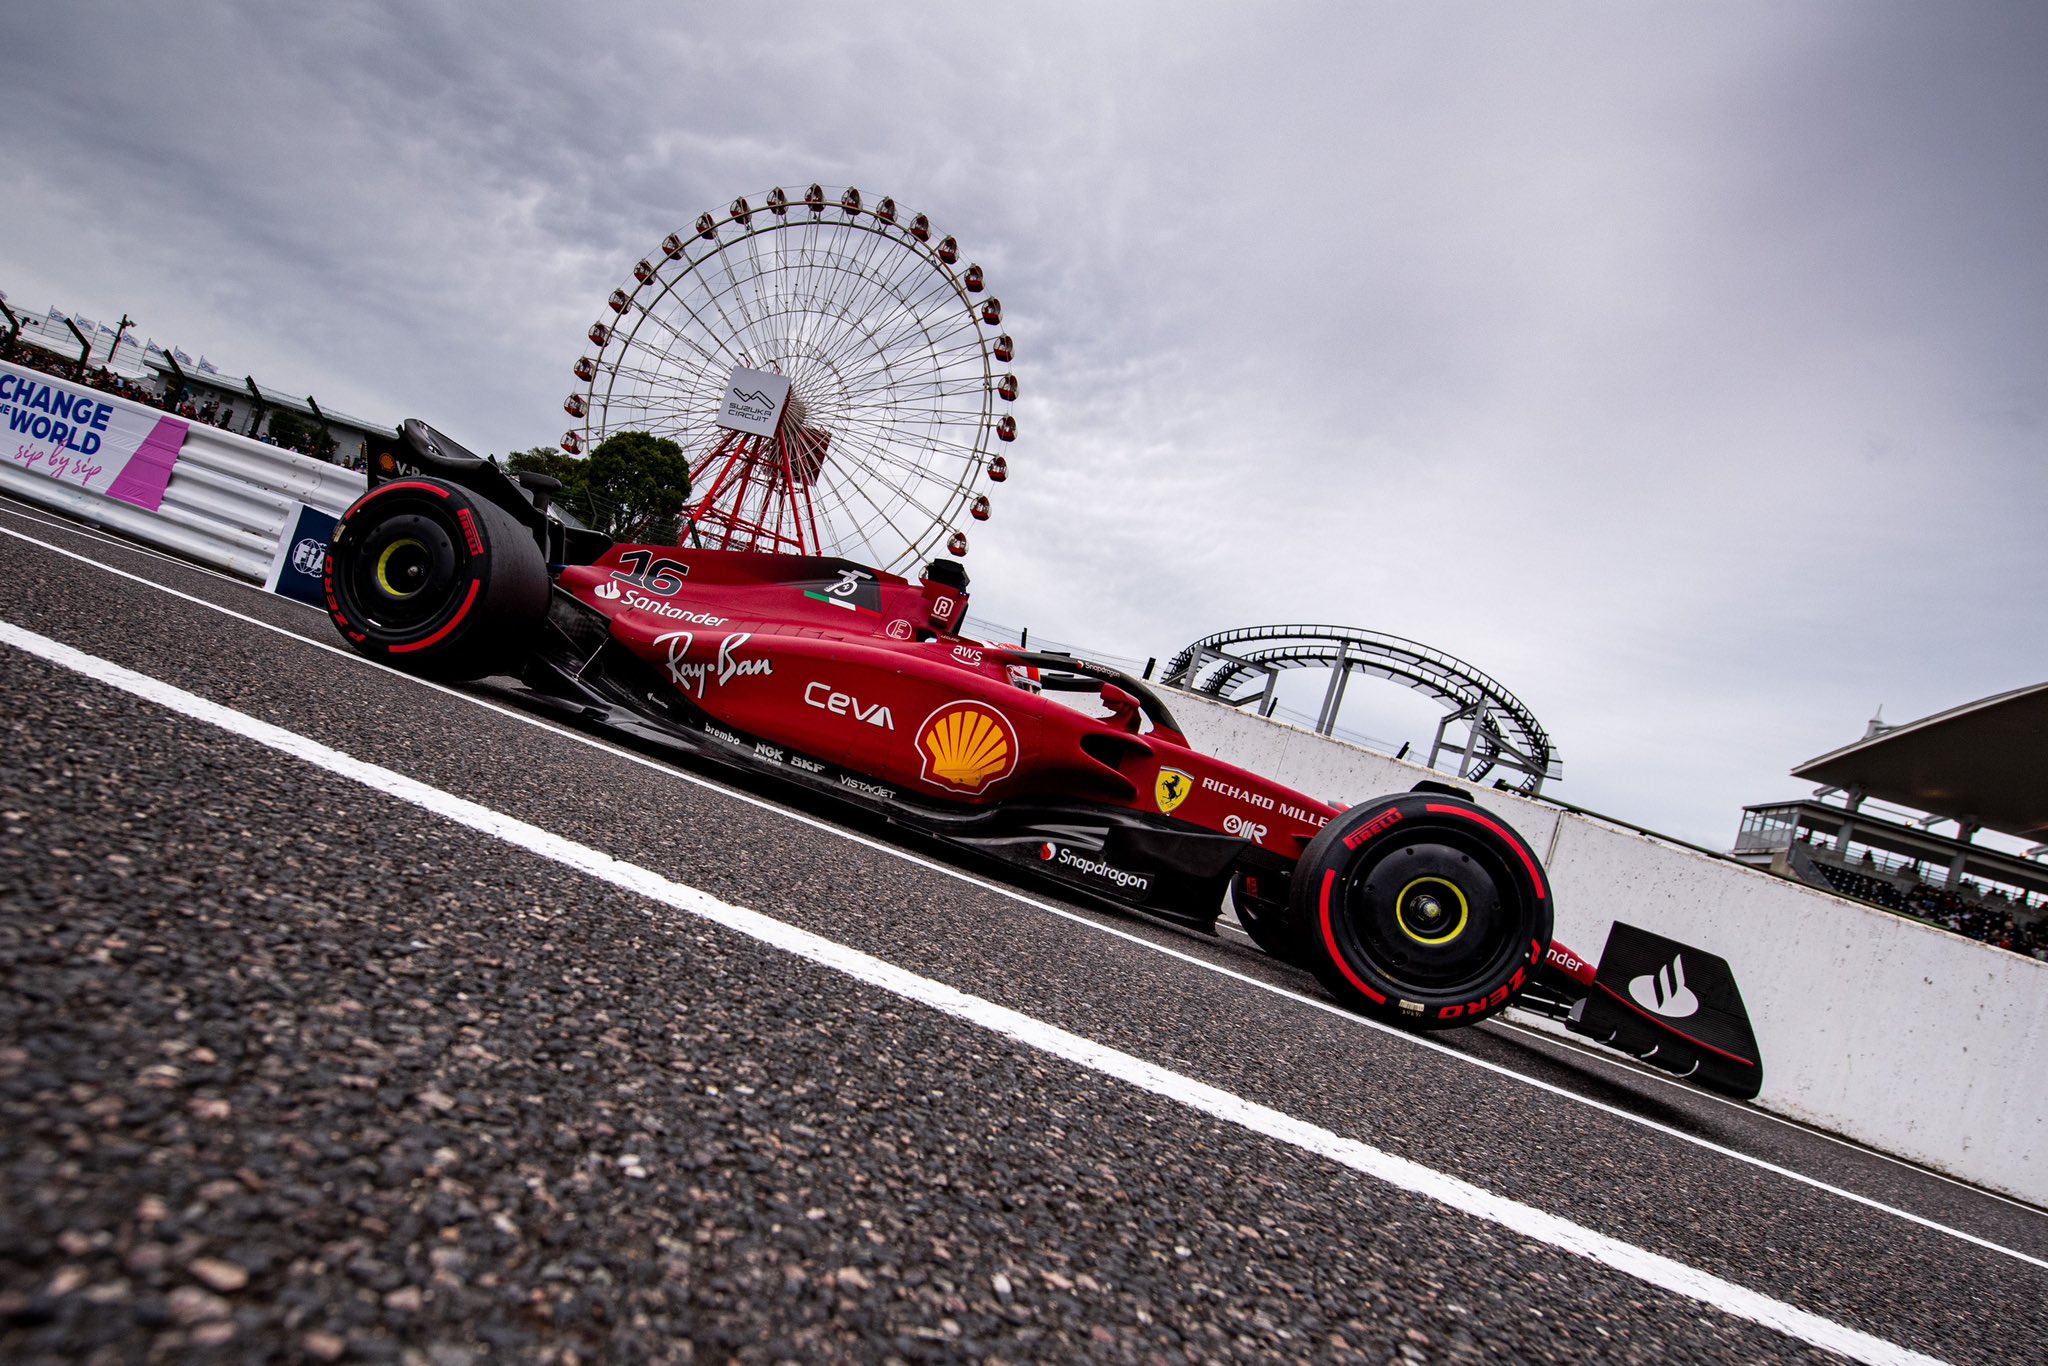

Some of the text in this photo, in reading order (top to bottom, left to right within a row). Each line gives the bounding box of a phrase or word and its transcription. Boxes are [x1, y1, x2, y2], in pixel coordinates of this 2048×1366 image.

[0, 374, 114, 432] CHANGE
[728, 409, 769, 423] CIRCUIT
[729, 402, 772, 417] SUZUKA
[0, 402, 101, 456] HE WORLD
[14, 438, 102, 486] sip by sip
[457, 508, 484, 556] PIRELLI
[610, 549, 690, 597] 16
[620, 589, 729, 627] Santander
[953, 645, 983, 662] aws
[1085, 662, 1120, 678] Snapdragon
[704, 722, 741, 746] brembo
[755, 742, 784, 761] NGK
[791, 755, 825, 773] SKF
[1202, 777, 1331, 829] RICHARD MILLE
[1343, 807, 1404, 851] PIRELLI
[1058, 848, 1148, 890] Snapdragon
[1546, 948, 1584, 972] nder
[1438, 966, 1528, 1020] ZERO
